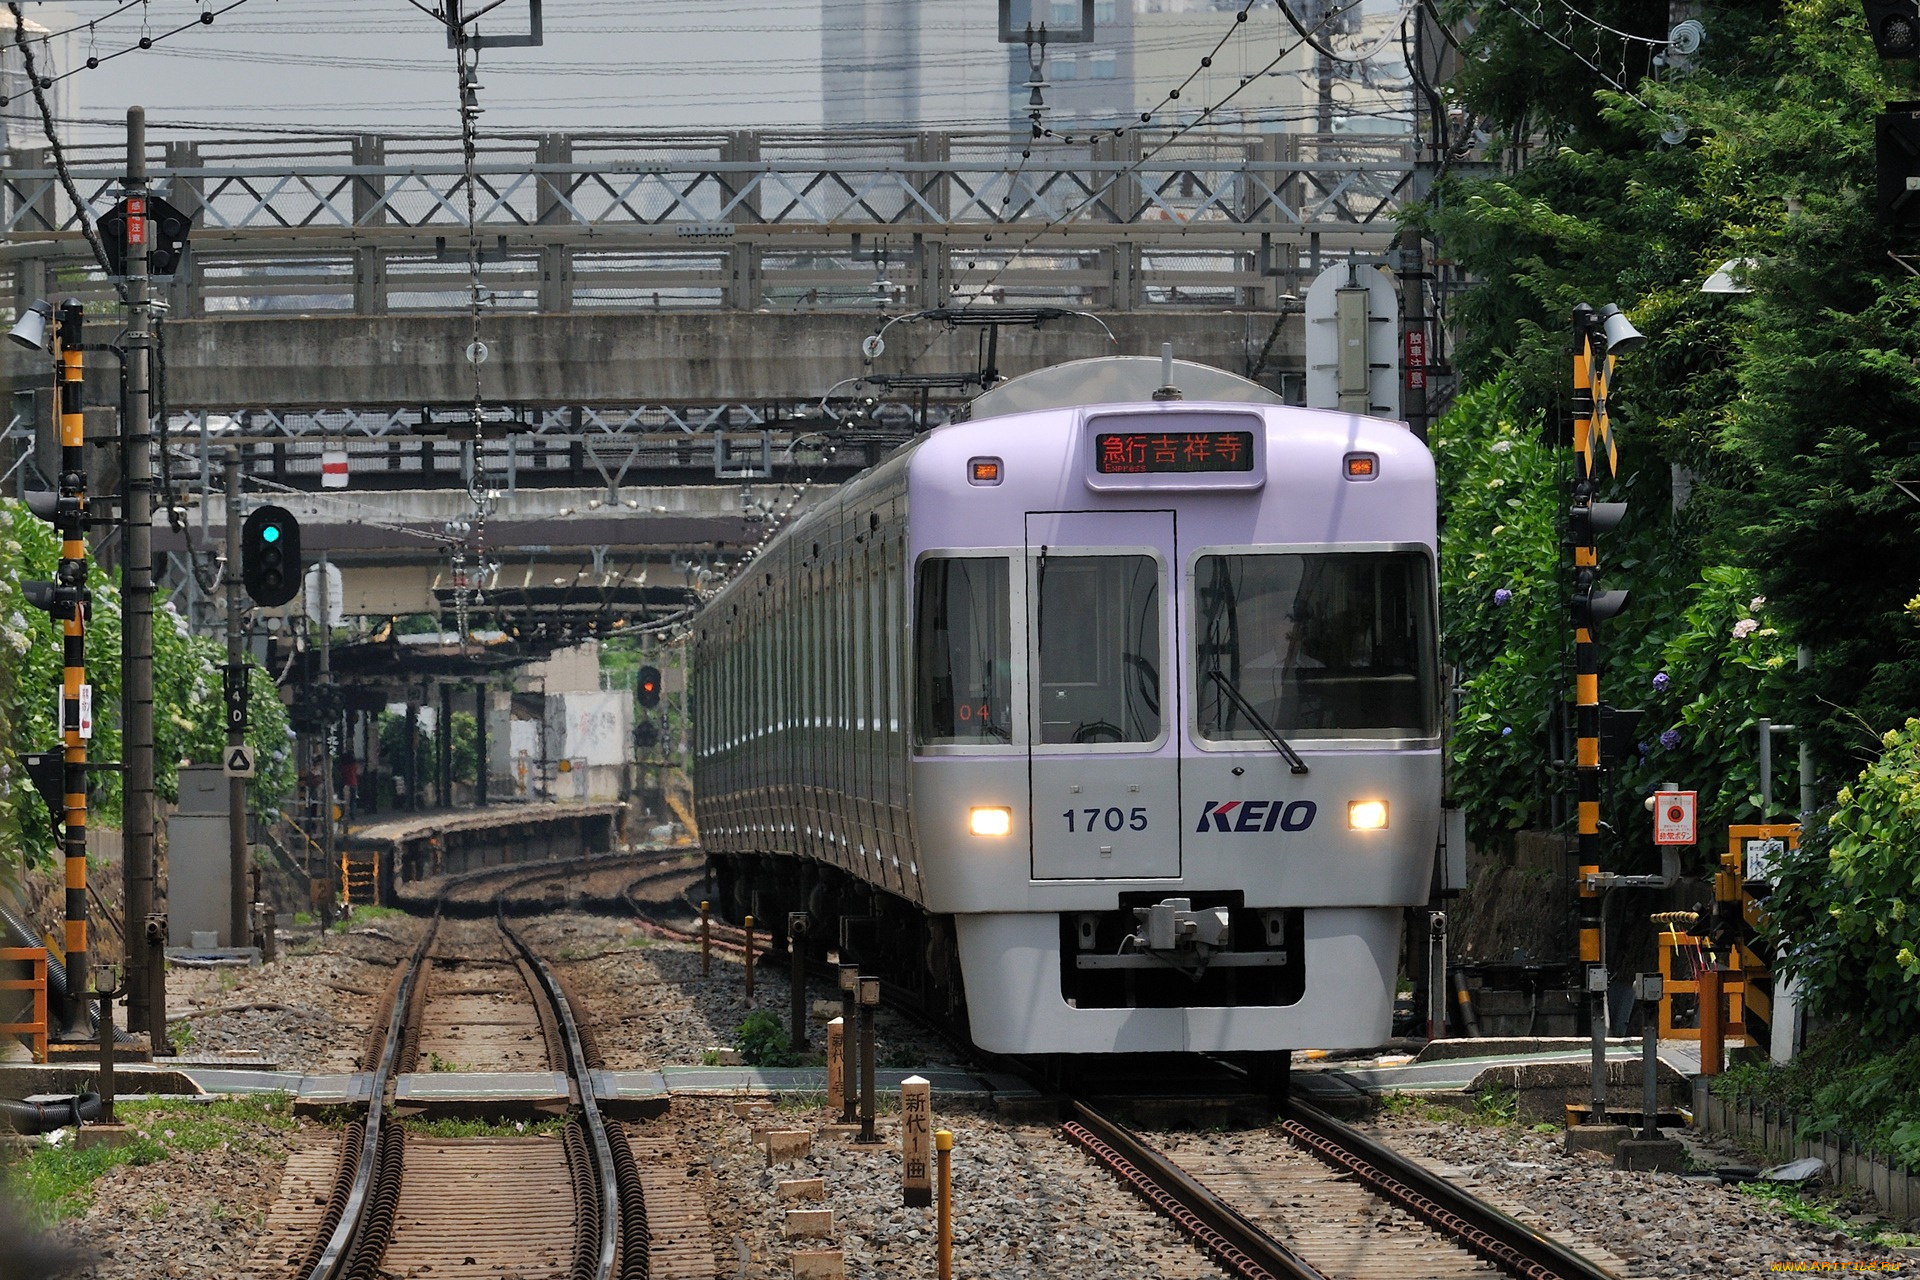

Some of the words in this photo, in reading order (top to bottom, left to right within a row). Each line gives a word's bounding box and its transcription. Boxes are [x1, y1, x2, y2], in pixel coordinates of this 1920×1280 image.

[1103, 436, 1148, 463] 急行
[1151, 434, 1242, 462] 吉祥寺
[960, 704, 989, 720] 04
[1063, 807, 1148, 832] 1705
[1196, 801, 1317, 832] KEIO
